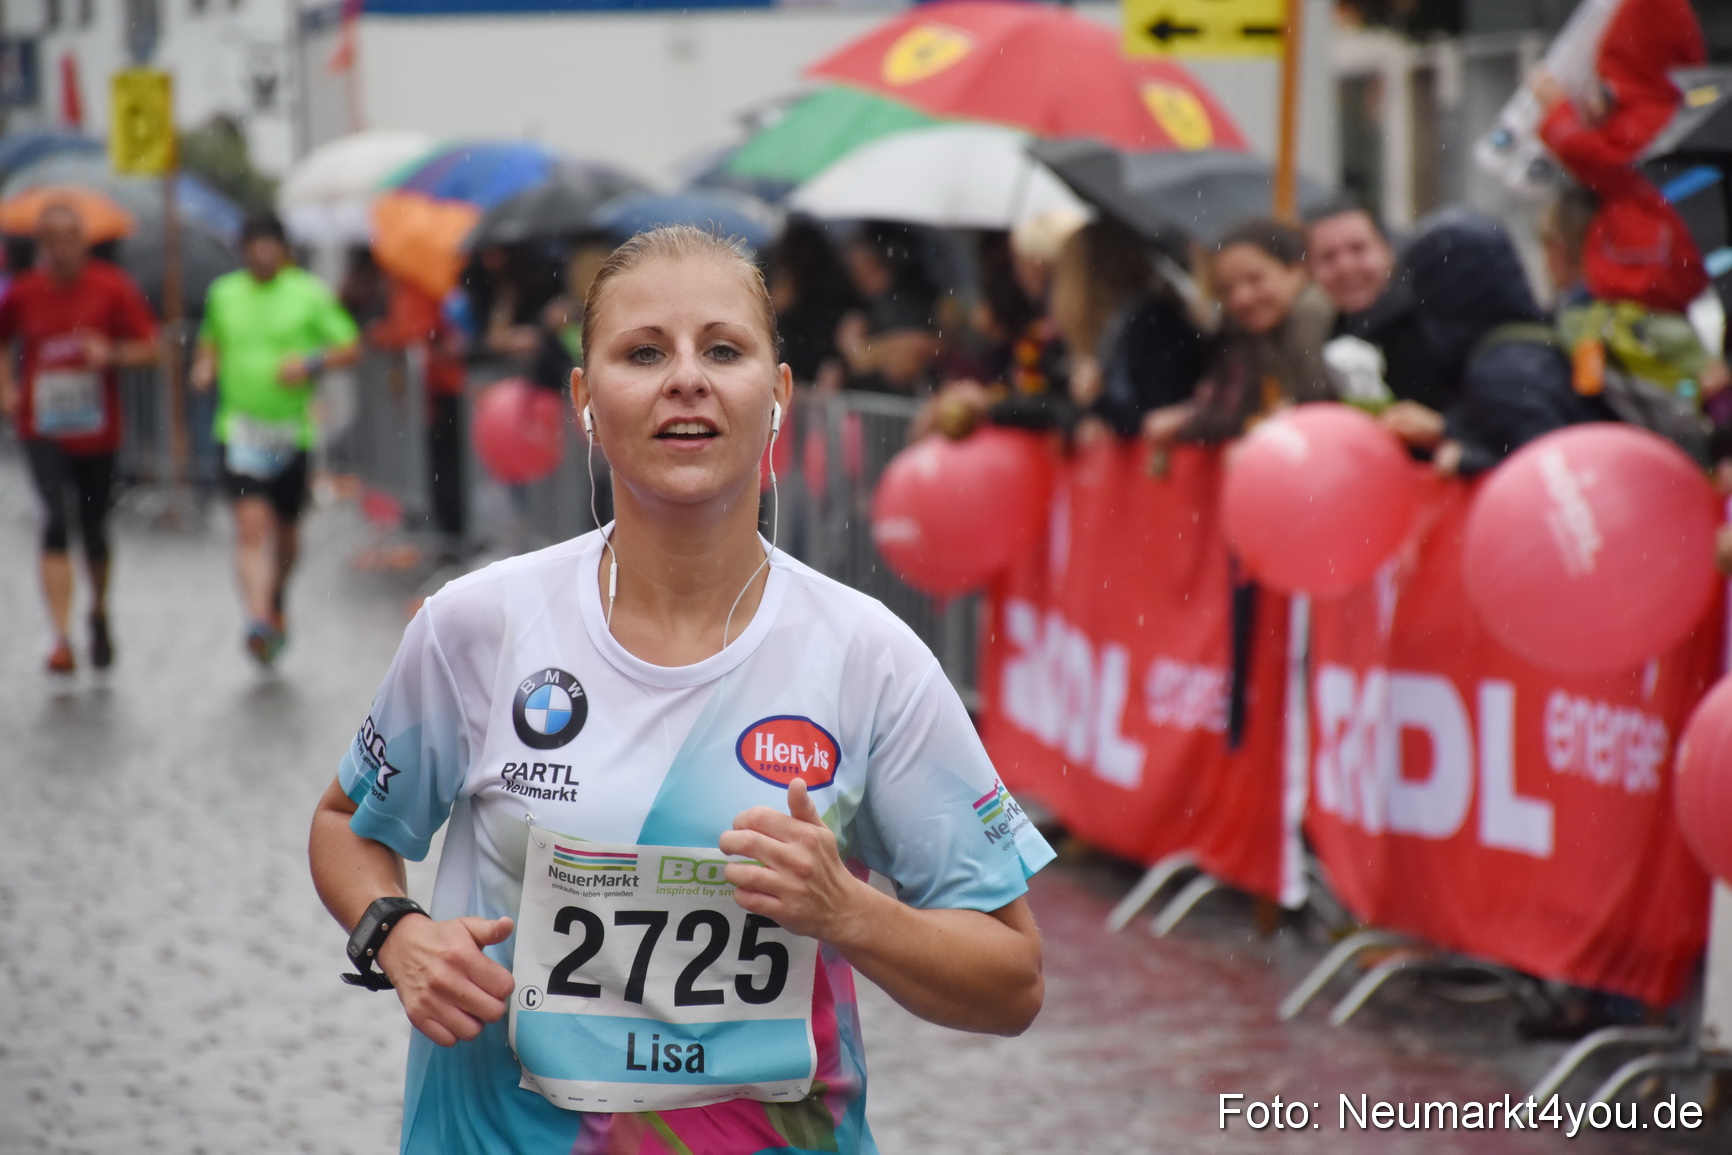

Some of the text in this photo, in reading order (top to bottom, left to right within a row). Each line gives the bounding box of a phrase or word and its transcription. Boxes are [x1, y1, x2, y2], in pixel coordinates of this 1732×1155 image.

[520, 669, 583, 699] BMW
[755, 732, 829, 772] Hervis
[501, 762, 579, 786] PARTL
[760, 763, 799, 775] SPORTS
[501, 779, 578, 803] Neumarkt
[548, 865, 640, 888] NeuerMarkt
[656, 885, 700, 897] inspired
[702, 886, 715, 898] by
[546, 905, 789, 1007] 2725
[626, 1032, 705, 1073] Lisa
